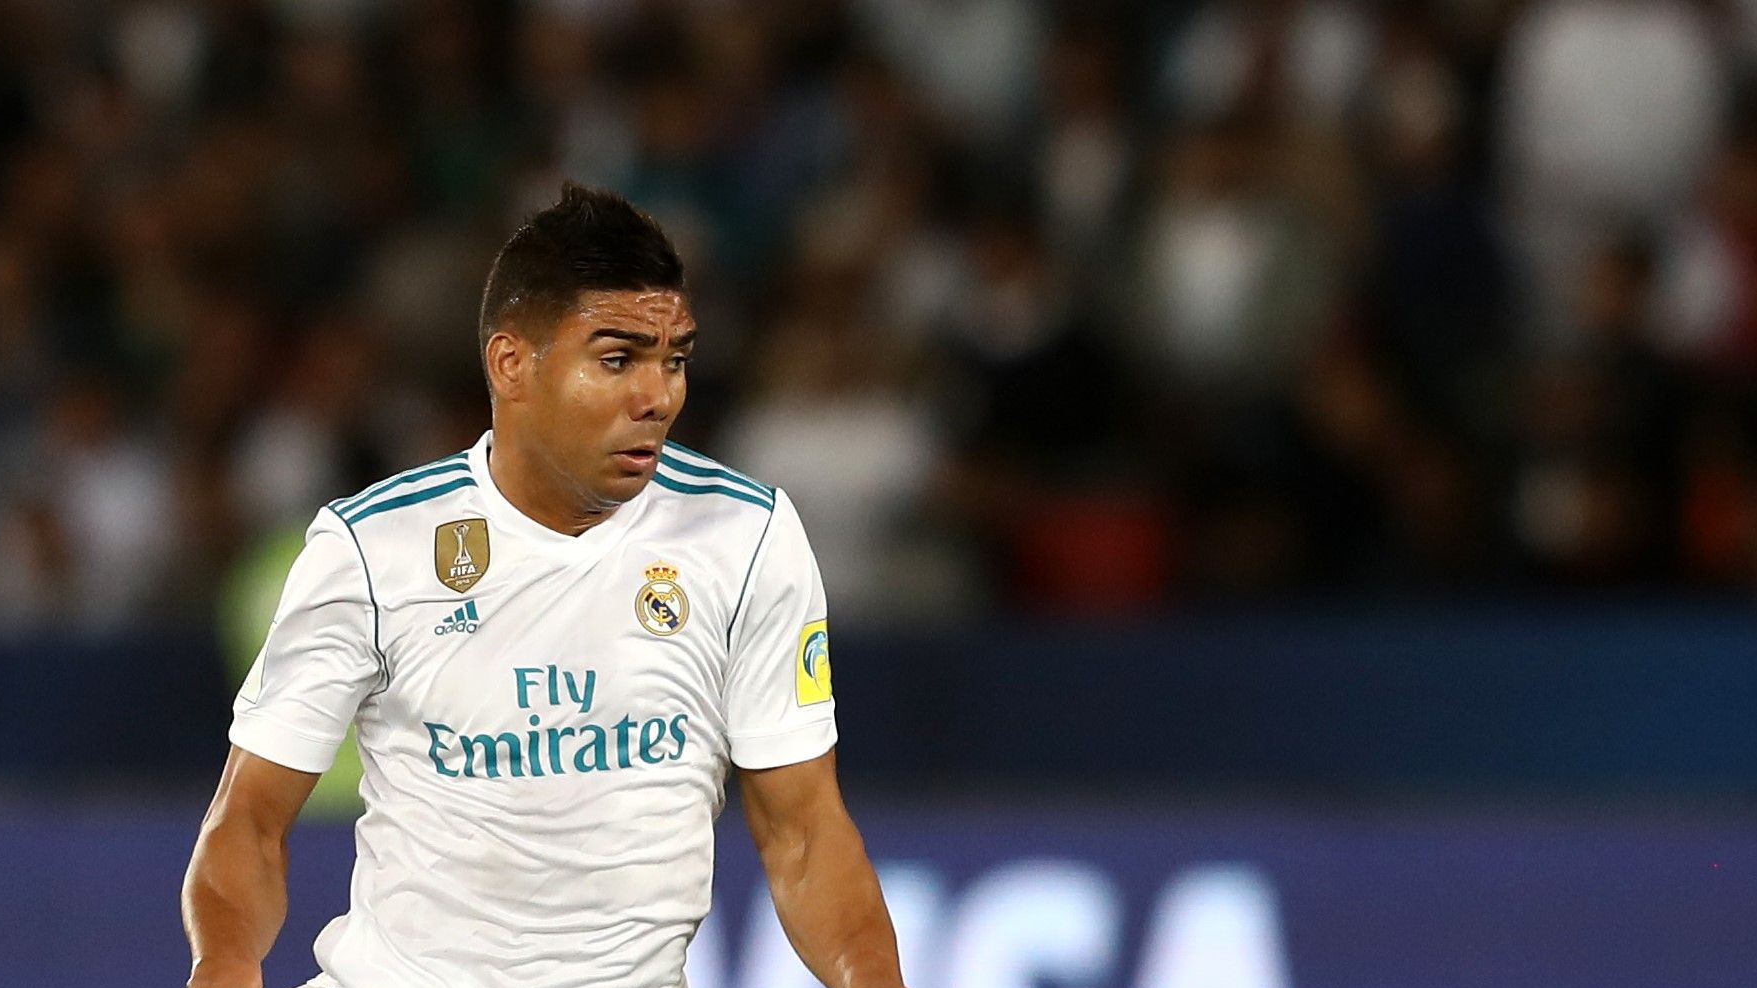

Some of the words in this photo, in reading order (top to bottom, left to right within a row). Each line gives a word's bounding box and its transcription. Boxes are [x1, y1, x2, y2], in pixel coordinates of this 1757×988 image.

[449, 564, 477, 578] FIFA
[434, 620, 482, 636] adda
[512, 663, 597, 714] Fly
[422, 712, 690, 780] Emirates
